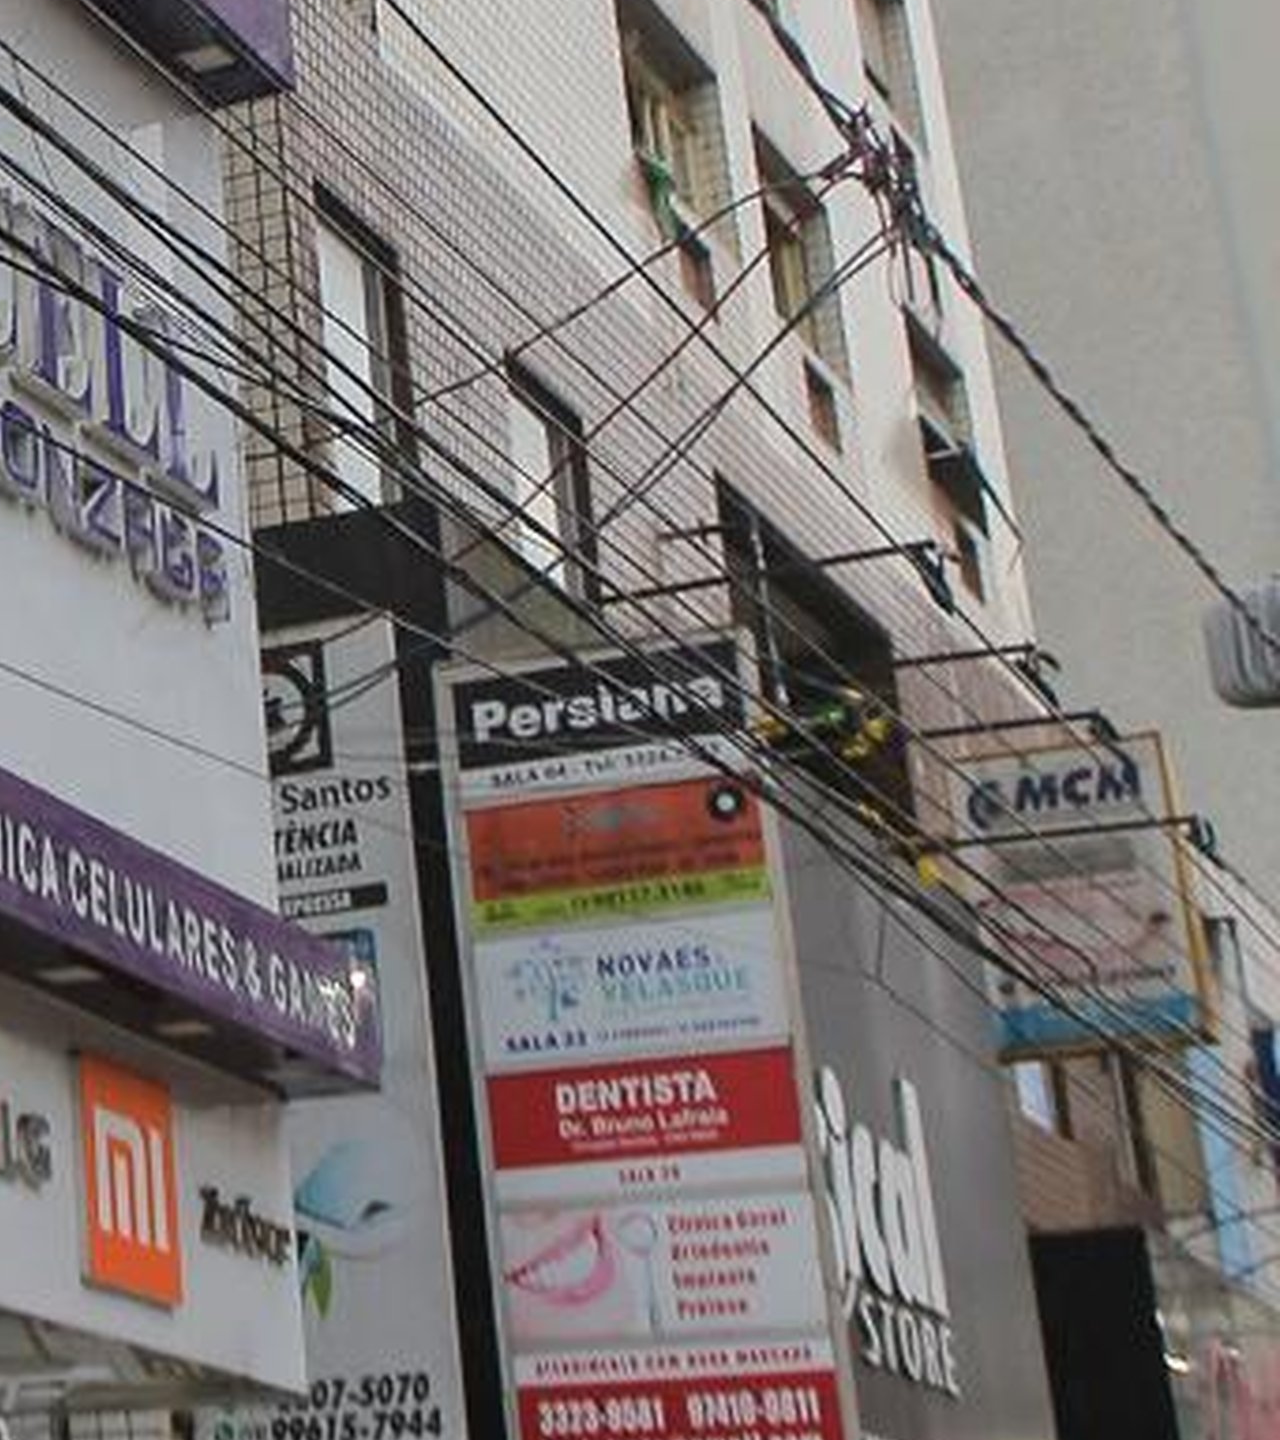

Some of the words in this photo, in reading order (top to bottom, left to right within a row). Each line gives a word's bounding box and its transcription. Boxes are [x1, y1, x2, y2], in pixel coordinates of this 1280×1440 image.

[280, 774, 393, 815] Santos
[67, 850, 238, 994] CELULARES
[596, 943, 712, 980] NOVAES
[554, 1068, 718, 1115] DENTISTA
[860, 1292, 964, 1400] STORE
